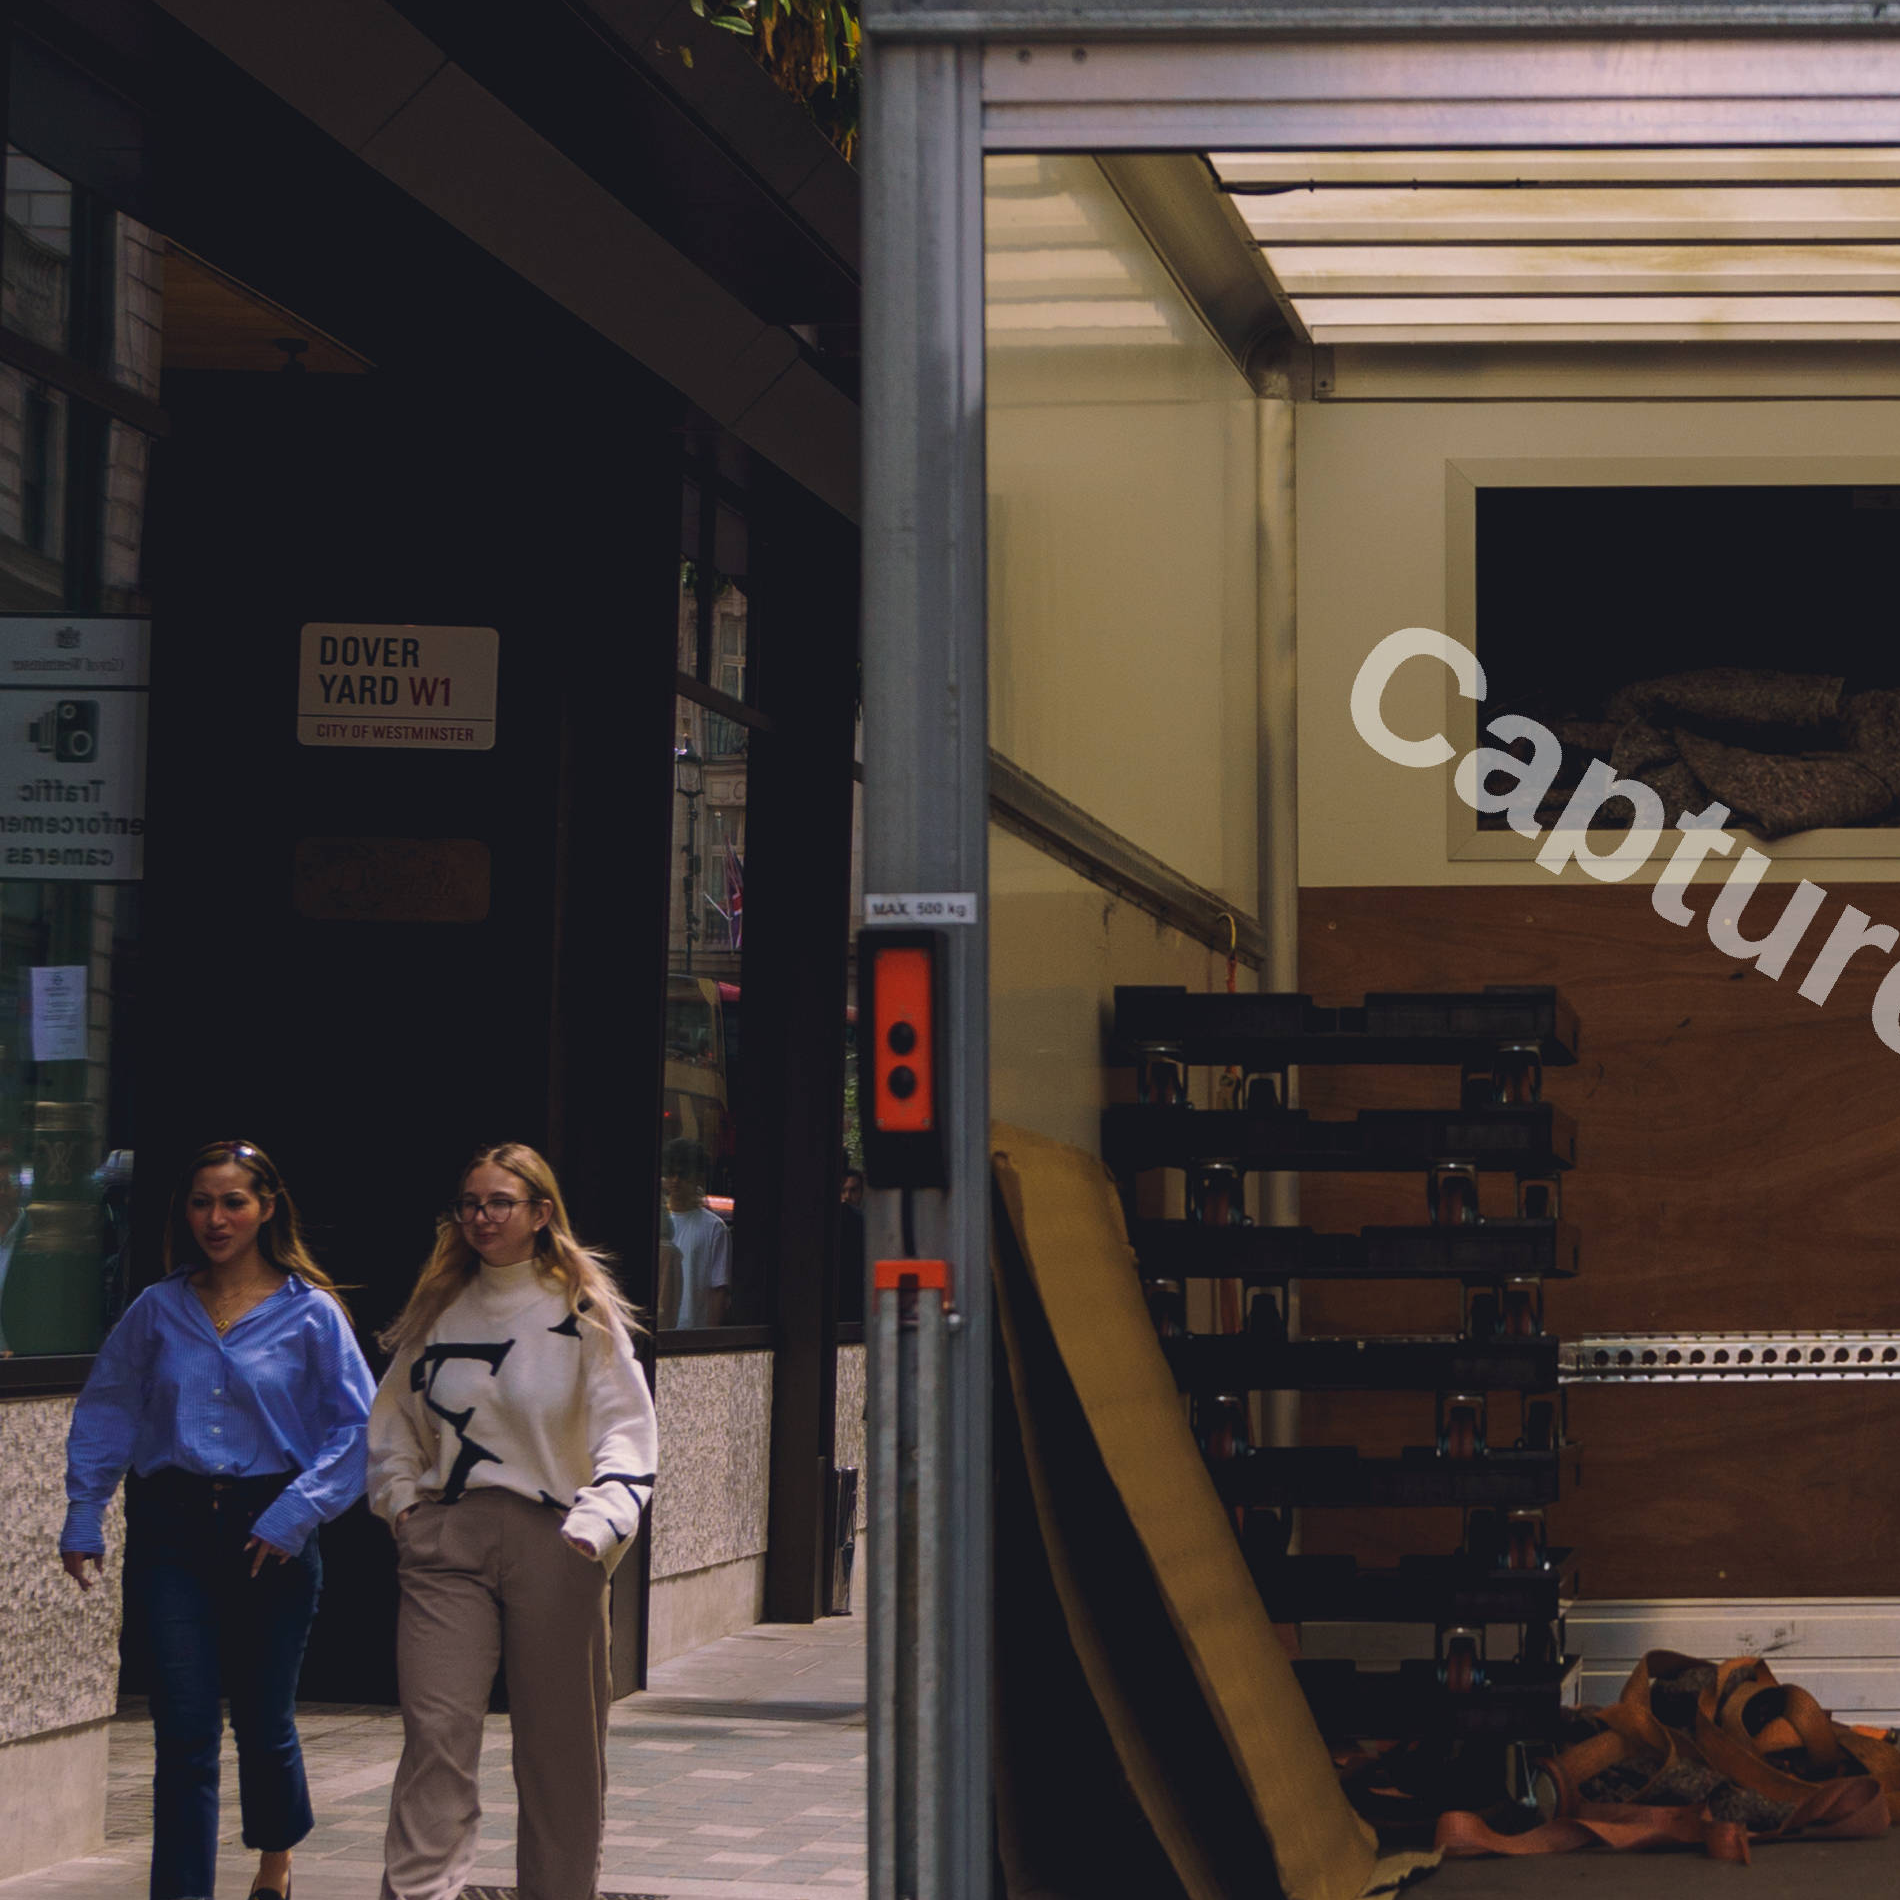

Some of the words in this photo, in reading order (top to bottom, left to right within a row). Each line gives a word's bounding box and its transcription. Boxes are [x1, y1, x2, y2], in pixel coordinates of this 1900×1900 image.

[320, 636, 420, 668] DOVER
[319, 674, 398, 706] YARD
[409, 676, 452, 707] W1
[317, 723, 349, 739] CITY
[351, 724, 369, 740] OF
[372, 725, 474, 742] WESTMINSTER
[947, 902, 967, 918] kg
